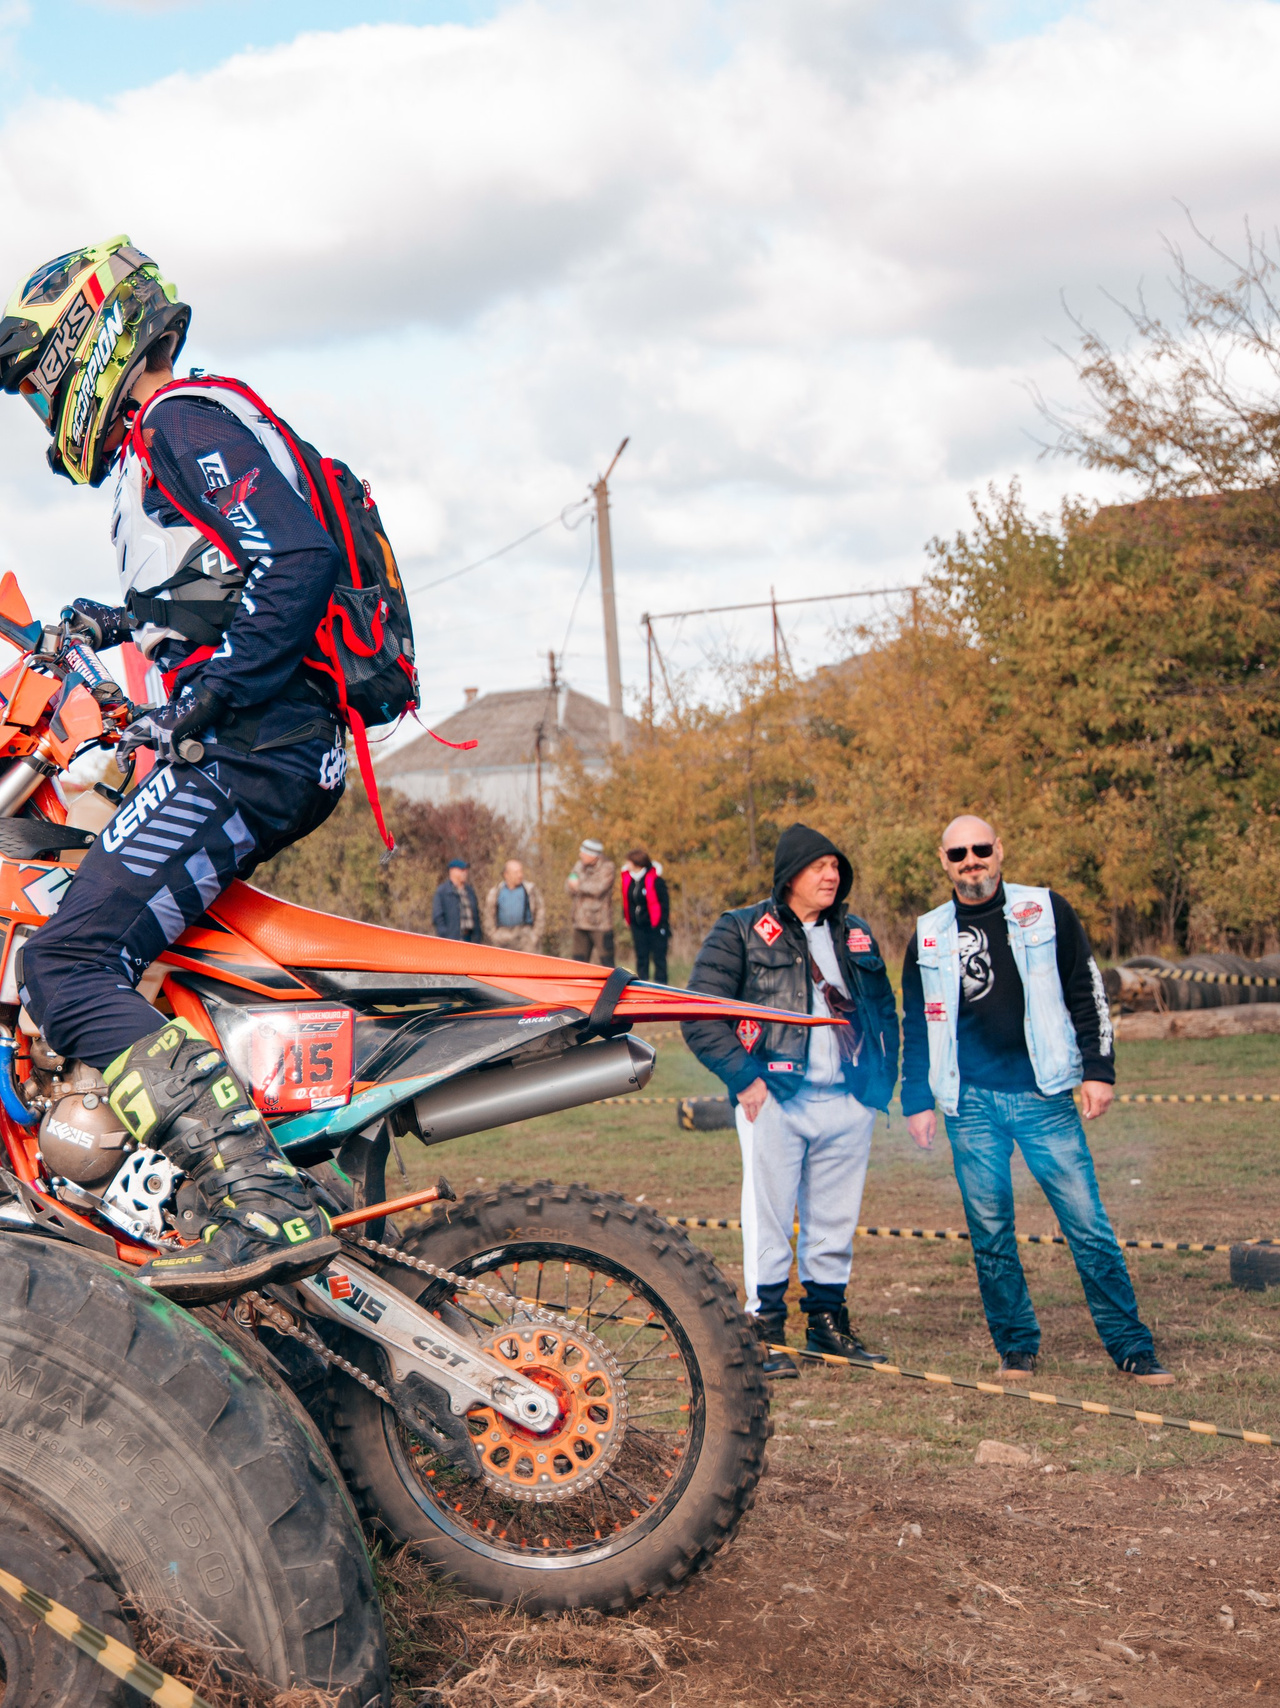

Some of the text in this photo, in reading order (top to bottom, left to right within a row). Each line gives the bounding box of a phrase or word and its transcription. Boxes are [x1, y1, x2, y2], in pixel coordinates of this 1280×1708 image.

[72, 299, 124, 446] SCORPION
[65, 648, 98, 687] RENTHAL
[46, 1118, 95, 1149] KEWS
[506, 1227, 573, 1240] X-GRIP
[314, 1267, 387, 1325] KEWS
[412, 1335, 469, 1367] CST
[135, 1516, 163, 1557] TUBE
